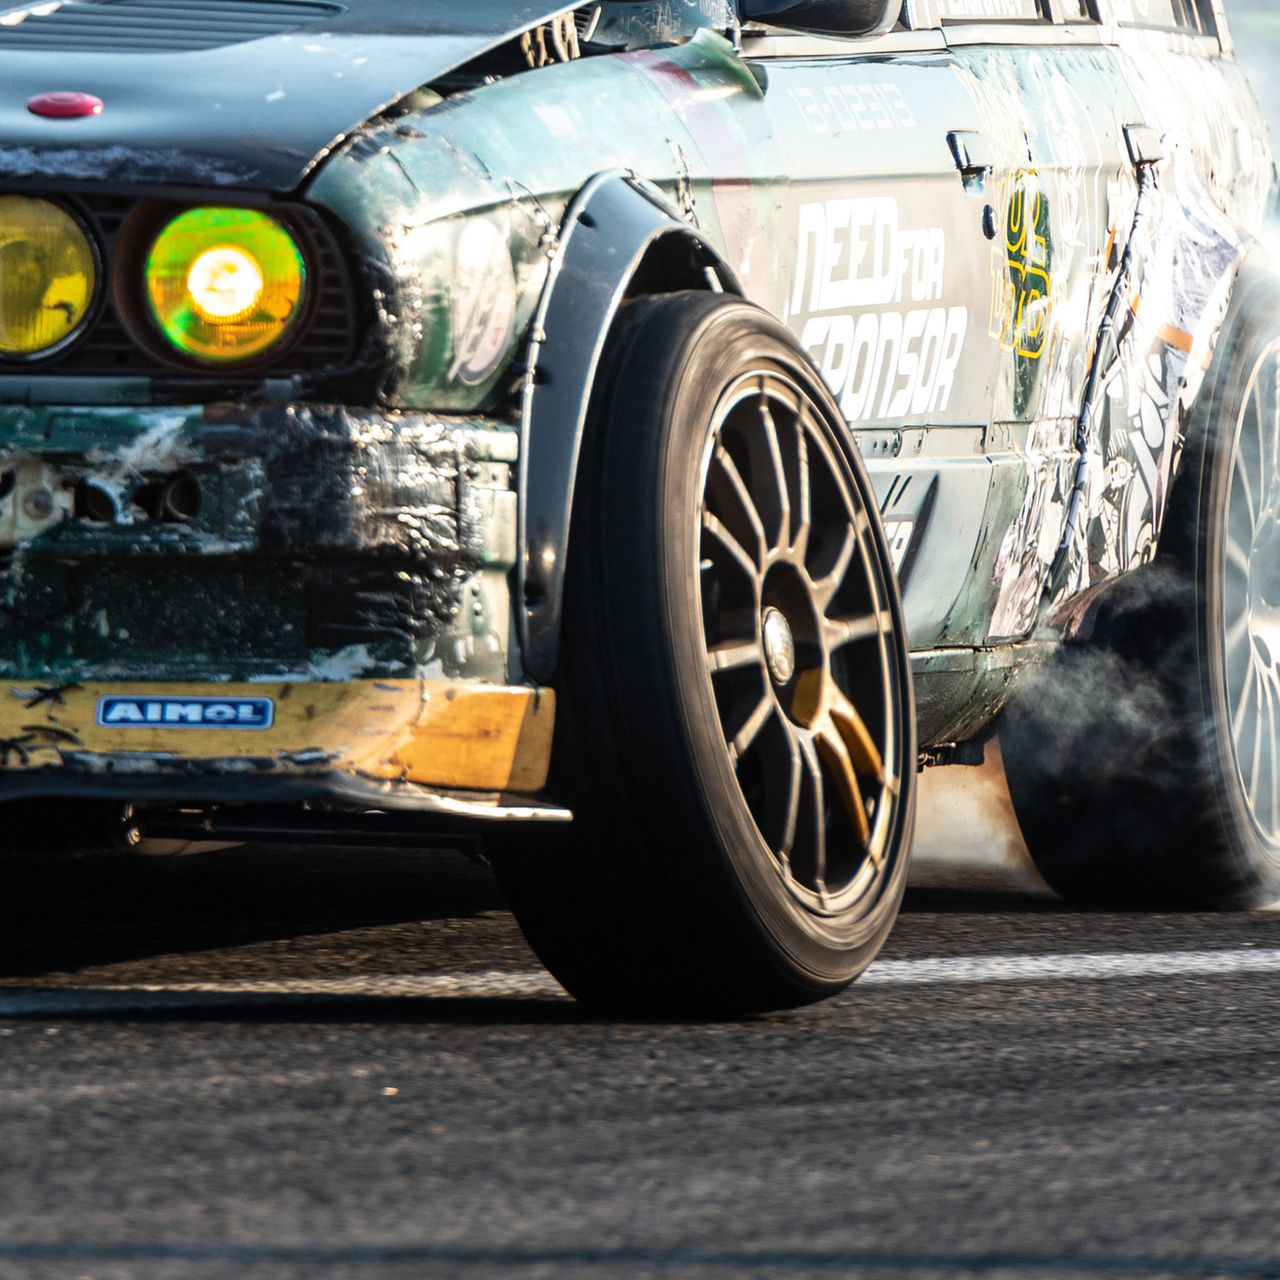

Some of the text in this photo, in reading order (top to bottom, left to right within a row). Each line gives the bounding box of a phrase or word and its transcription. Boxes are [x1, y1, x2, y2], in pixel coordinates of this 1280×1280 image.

[790, 196, 899, 316] NEED
[894, 228, 945, 303] FOR
[105, 702, 263, 723] AIMOL
